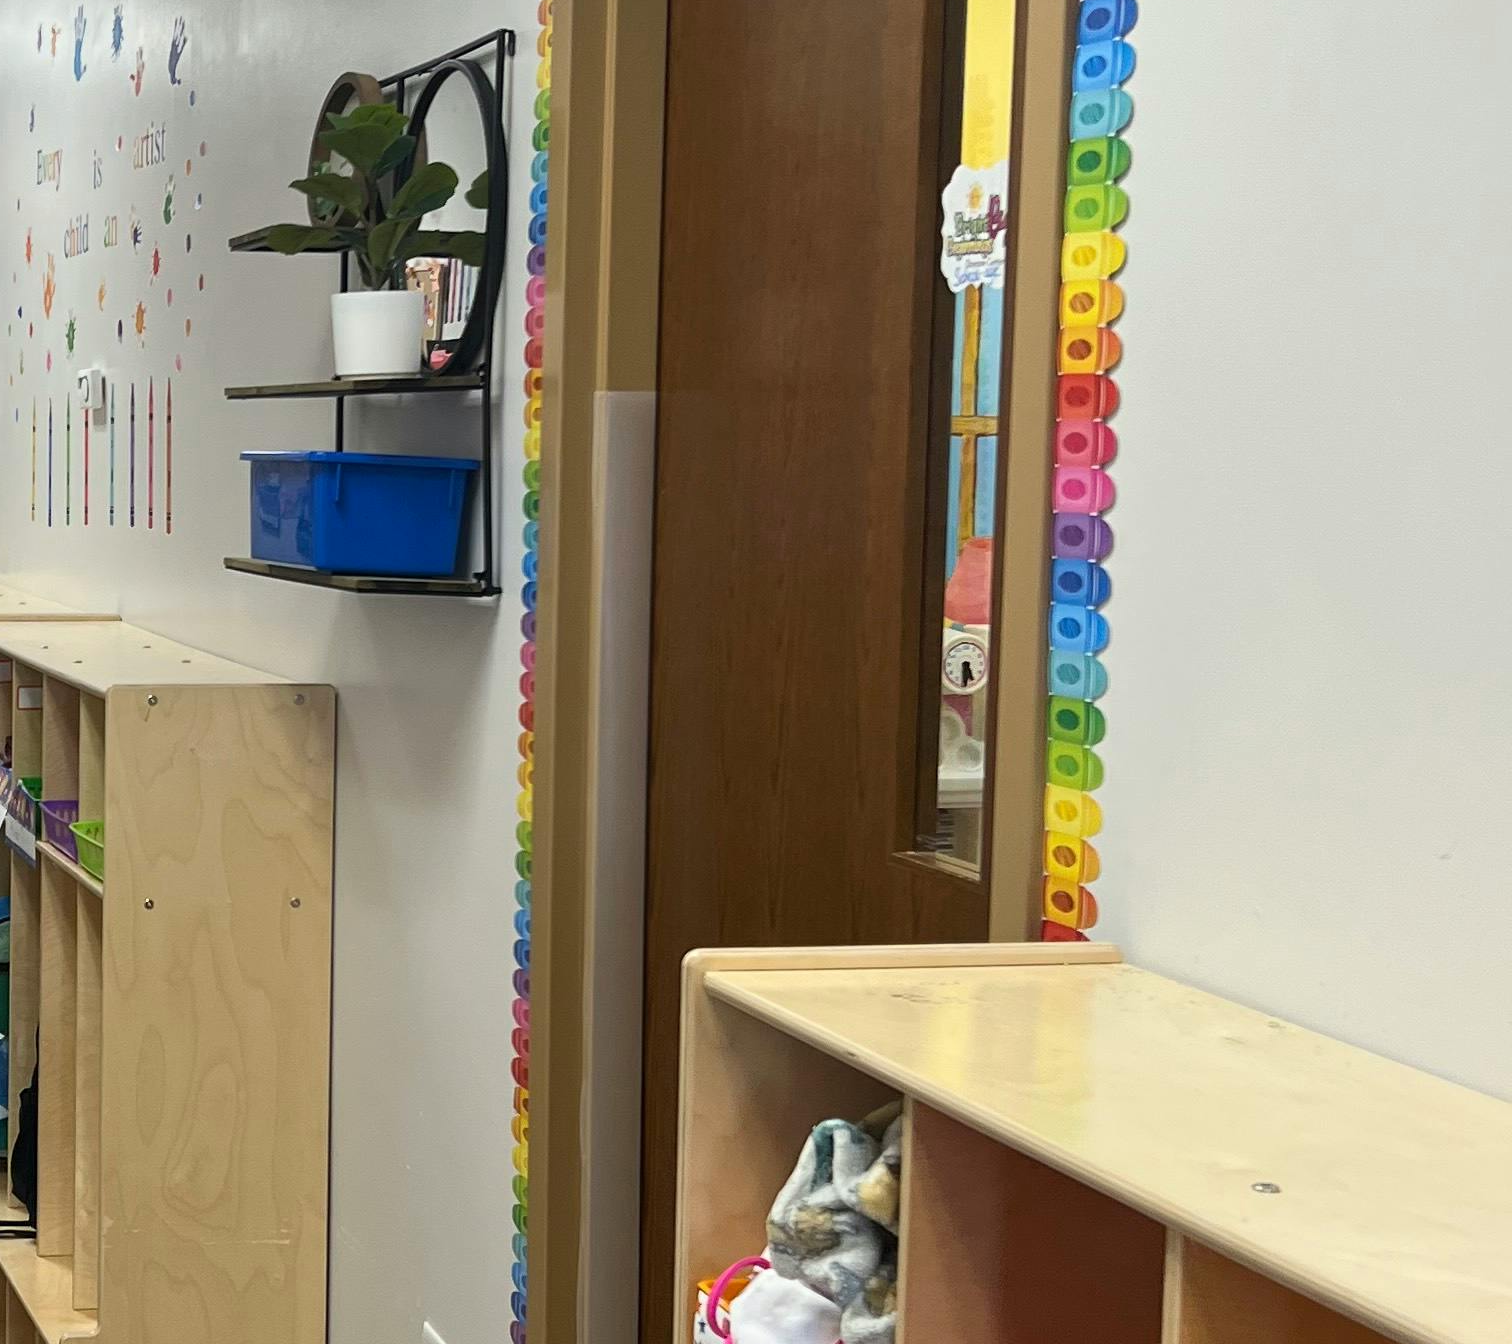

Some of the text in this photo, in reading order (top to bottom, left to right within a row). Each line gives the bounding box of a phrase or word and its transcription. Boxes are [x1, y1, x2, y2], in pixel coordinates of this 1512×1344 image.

[36, 121, 166, 259] Every child is an artist
